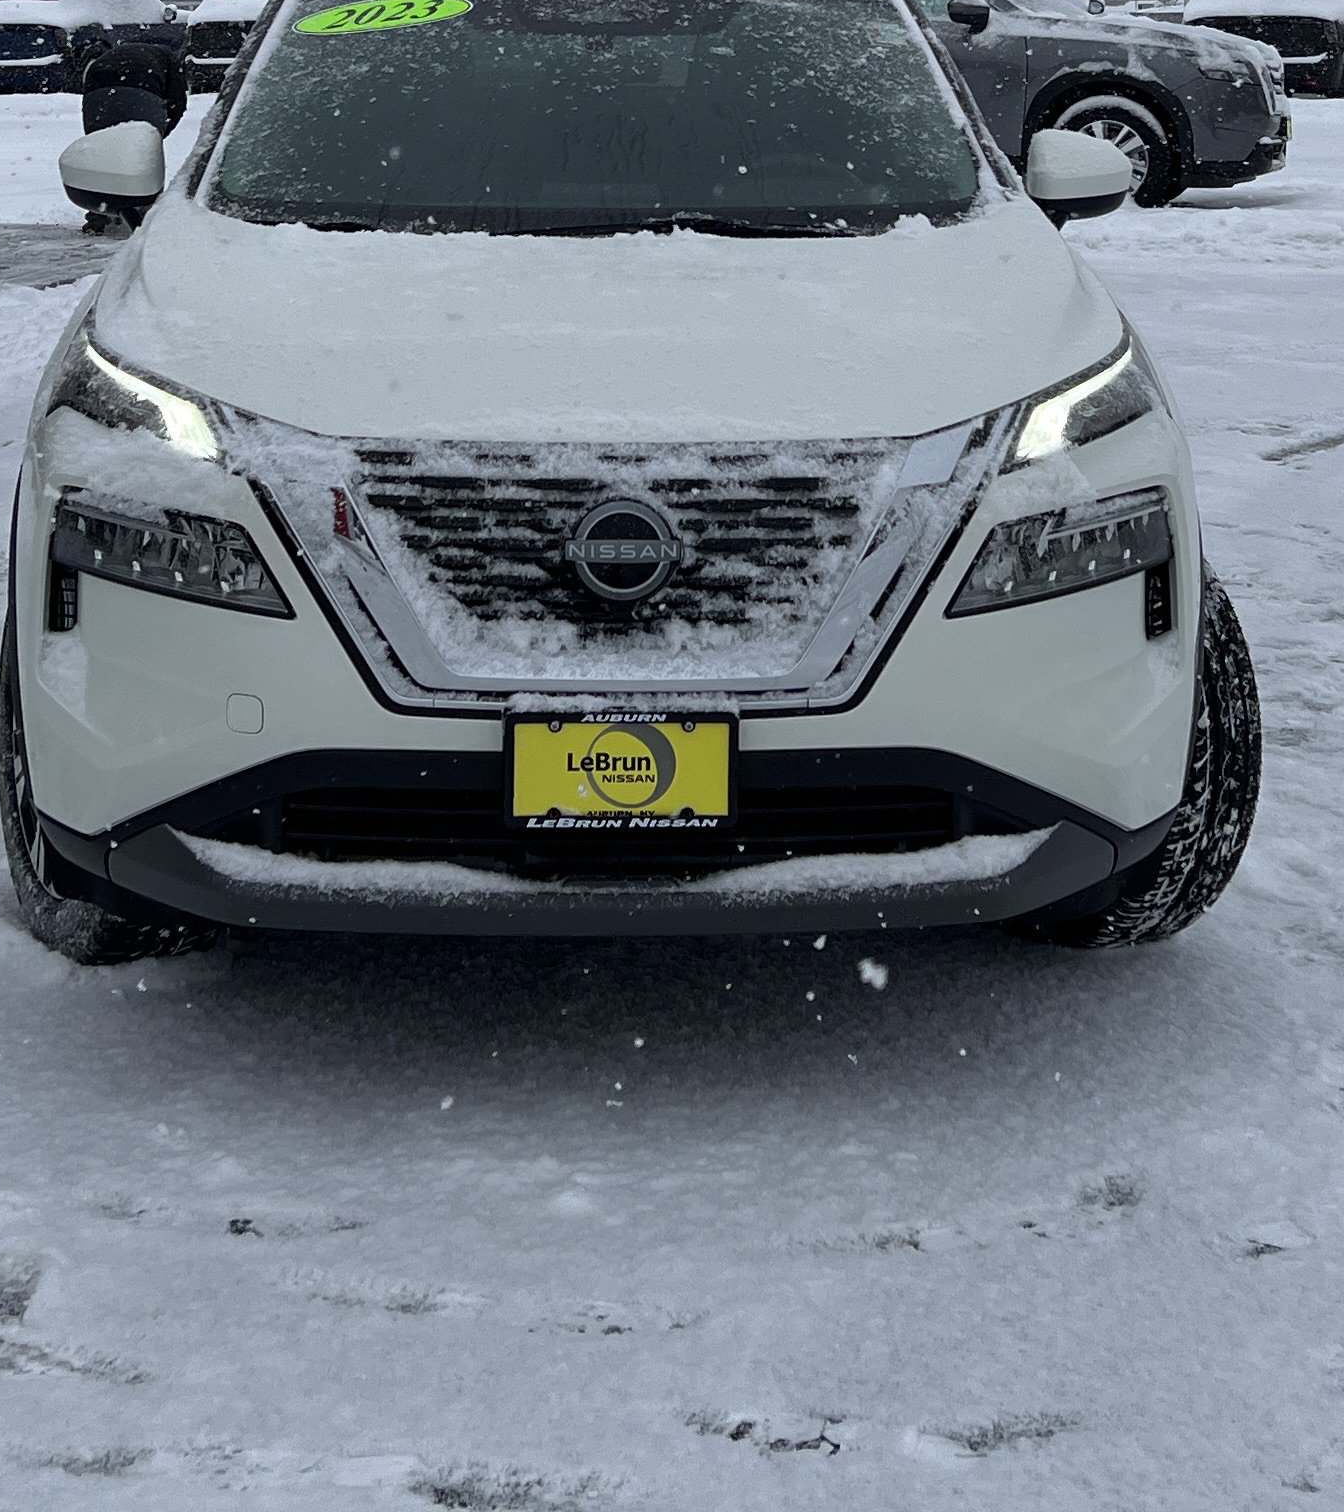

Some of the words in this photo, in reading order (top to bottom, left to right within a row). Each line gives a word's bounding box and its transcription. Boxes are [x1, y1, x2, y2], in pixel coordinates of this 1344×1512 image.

[320, 0, 444, 30] 2023
[568, 544, 677, 559] NISSAN
[581, 713, 666, 723] AUBURN
[567, 752, 651, 772] LeBrun
[602, 774, 655, 783] NISSAN
